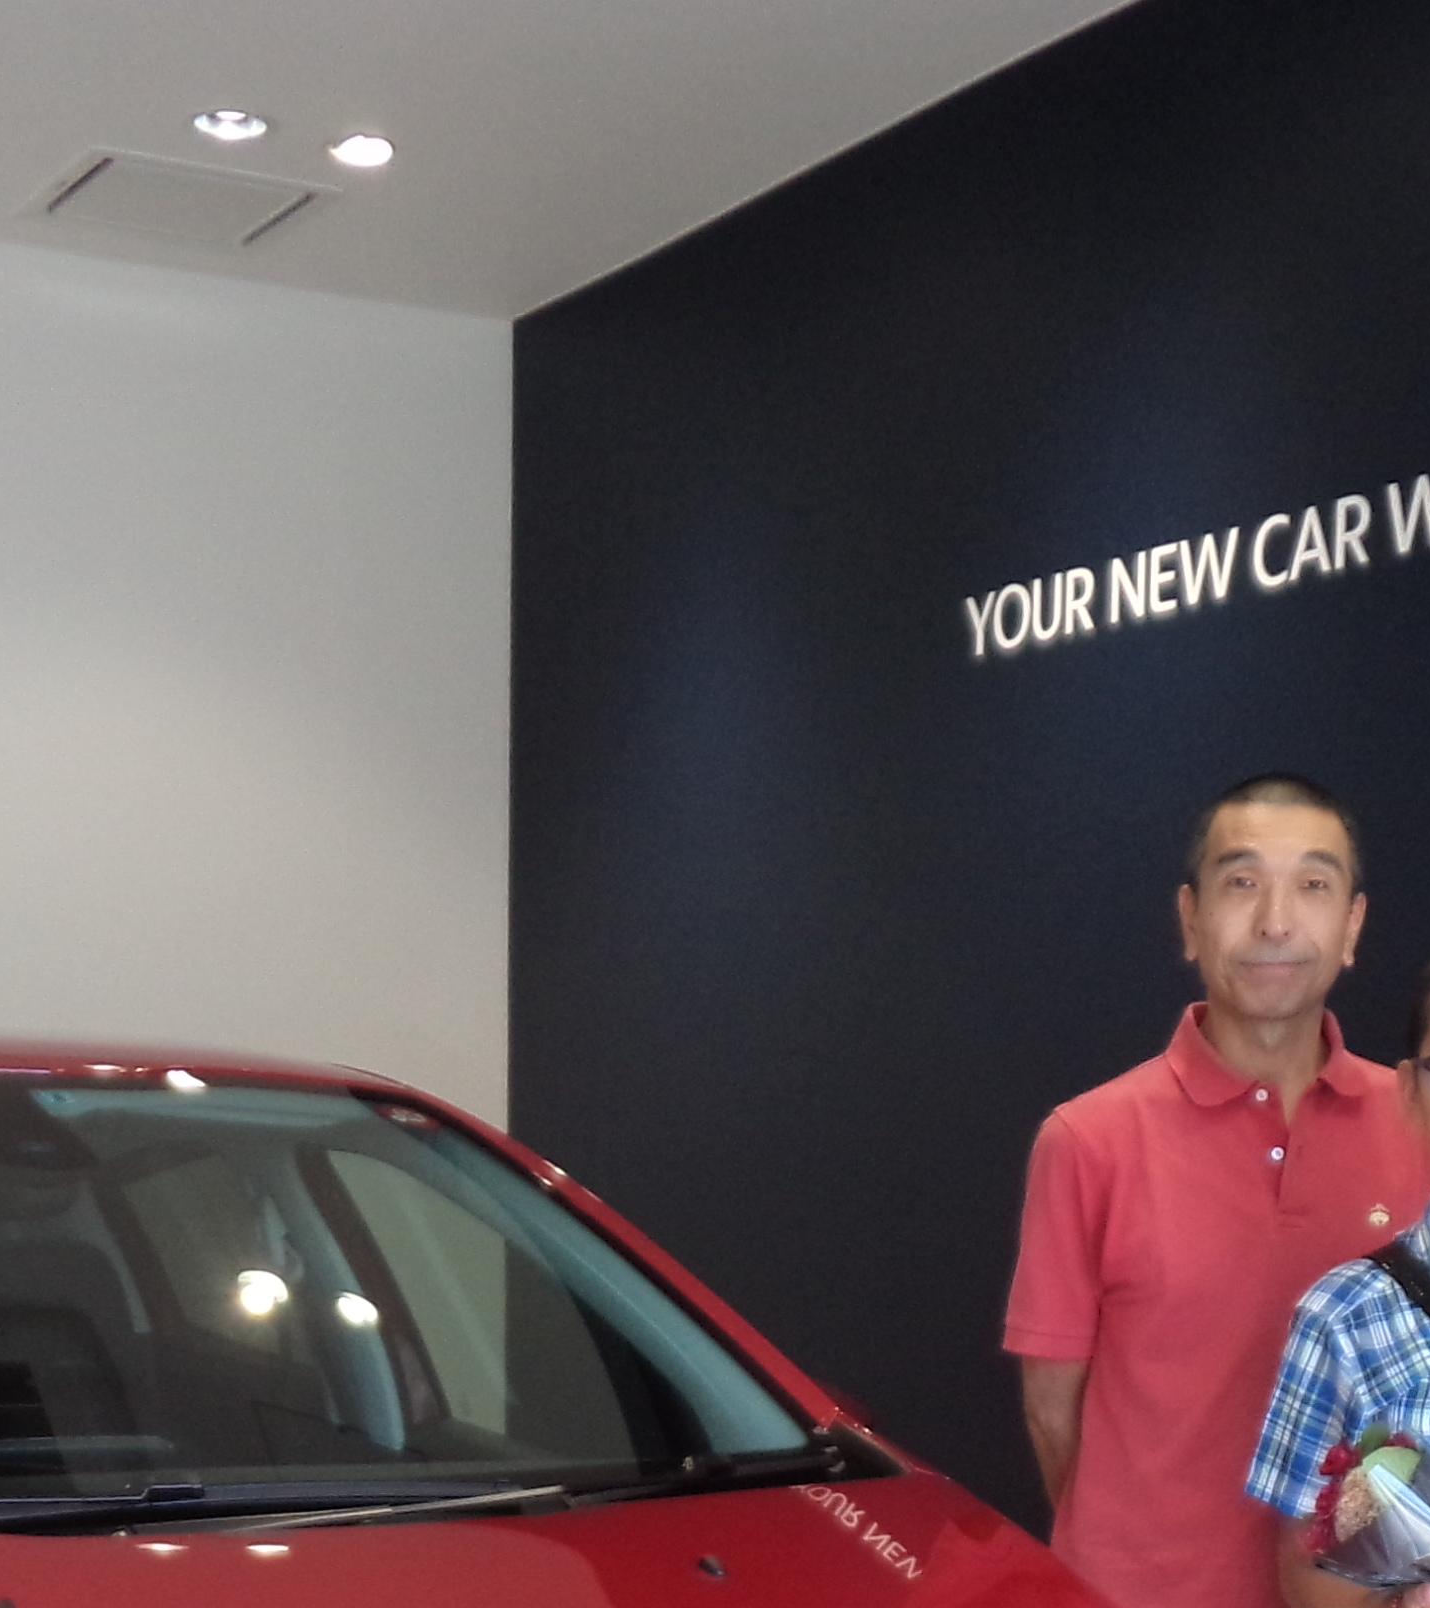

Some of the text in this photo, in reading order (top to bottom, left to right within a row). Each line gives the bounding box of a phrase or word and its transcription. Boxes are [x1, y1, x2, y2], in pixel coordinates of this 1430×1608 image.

[965, 566, 1096, 656] YOUR
[1107, 525, 1241, 626] NEW
[1251, 494, 1372, 590] CAR
